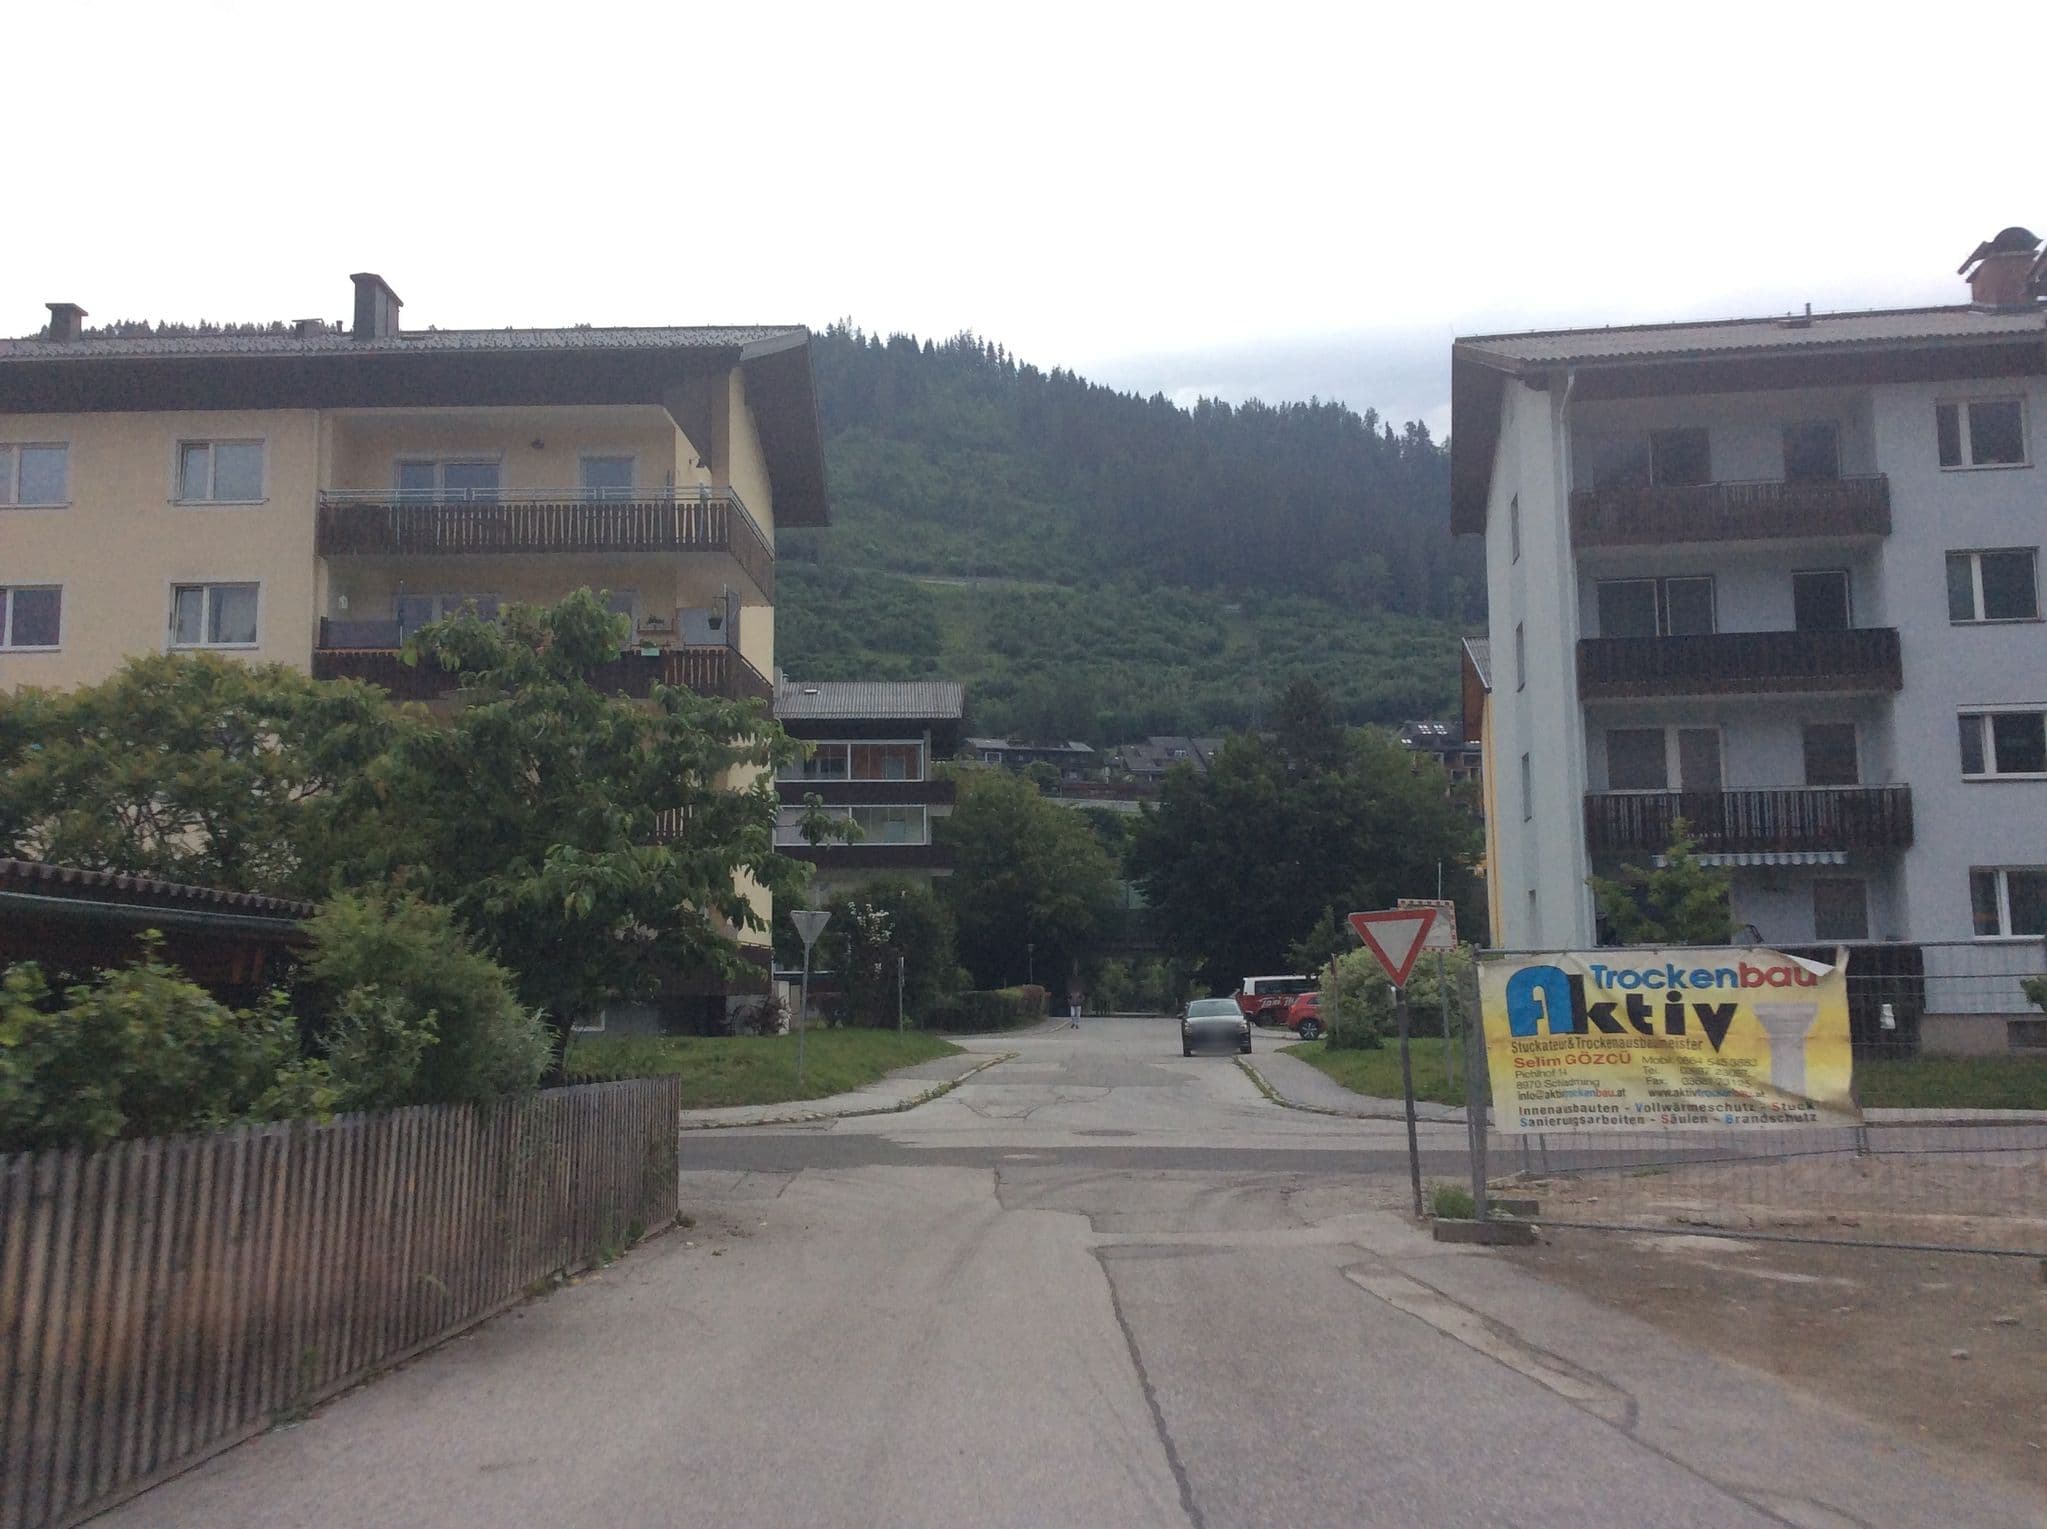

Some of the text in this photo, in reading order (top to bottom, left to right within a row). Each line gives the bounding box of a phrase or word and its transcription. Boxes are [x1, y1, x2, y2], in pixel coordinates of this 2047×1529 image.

[1590, 962, 1818, 990] Trockenbau
[1506, 964, 1737, 1053] Aktiv
[1513, 1051, 1632, 1069] Selim GÖZCÜ
[1516, 1079, 1600, 1090] 8970 Schladming
[1518, 1100, 1815, 1116] Innenausbauten Vollwärmeschutz Stuck
[1519, 1111, 1818, 1128] Sanierungsarbeiten Säulen Brandschutz
